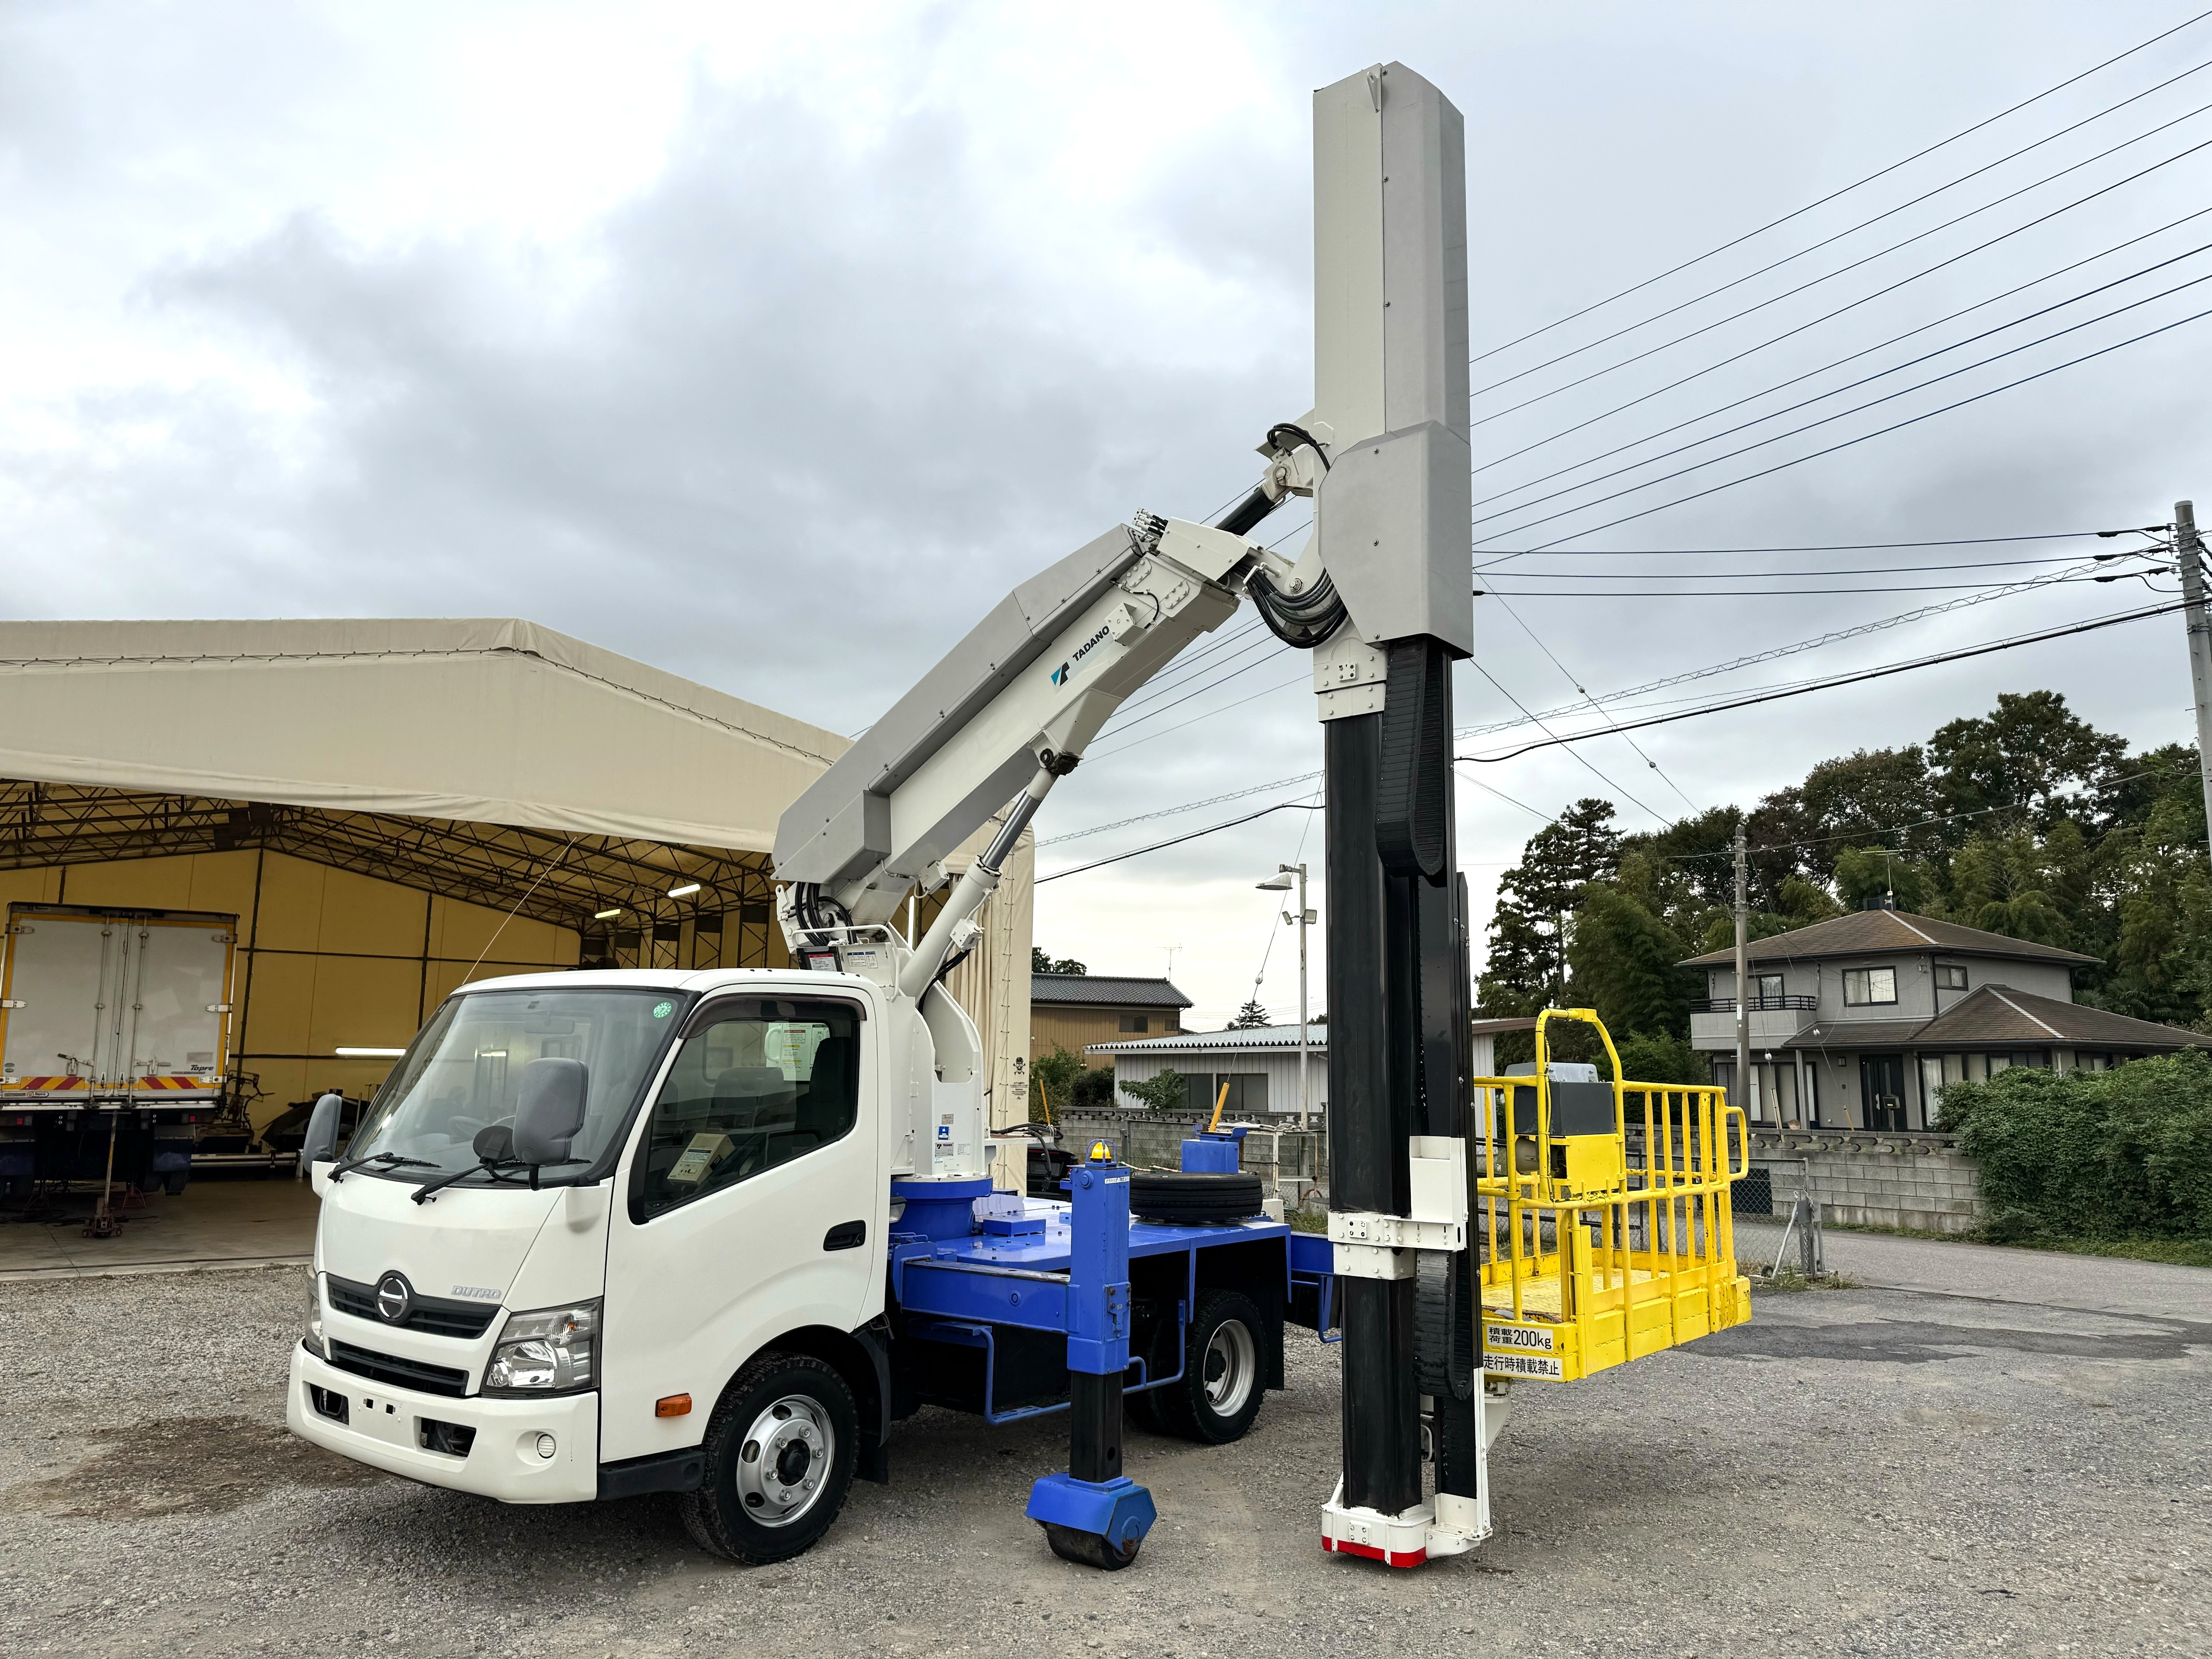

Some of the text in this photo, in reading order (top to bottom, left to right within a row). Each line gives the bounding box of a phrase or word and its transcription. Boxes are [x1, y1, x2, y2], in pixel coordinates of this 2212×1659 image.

[1072, 626, 1109, 661] TADANO
[451, 1285, 501, 1299] DUTRO
[1489, 1327, 1513, 1336] 積載
[1489, 1335, 1513, 1344] 荷重
[1513, 1329, 1552, 1349] 200kg
[1484, 1354, 1559, 1376] 走行時積載禁止
